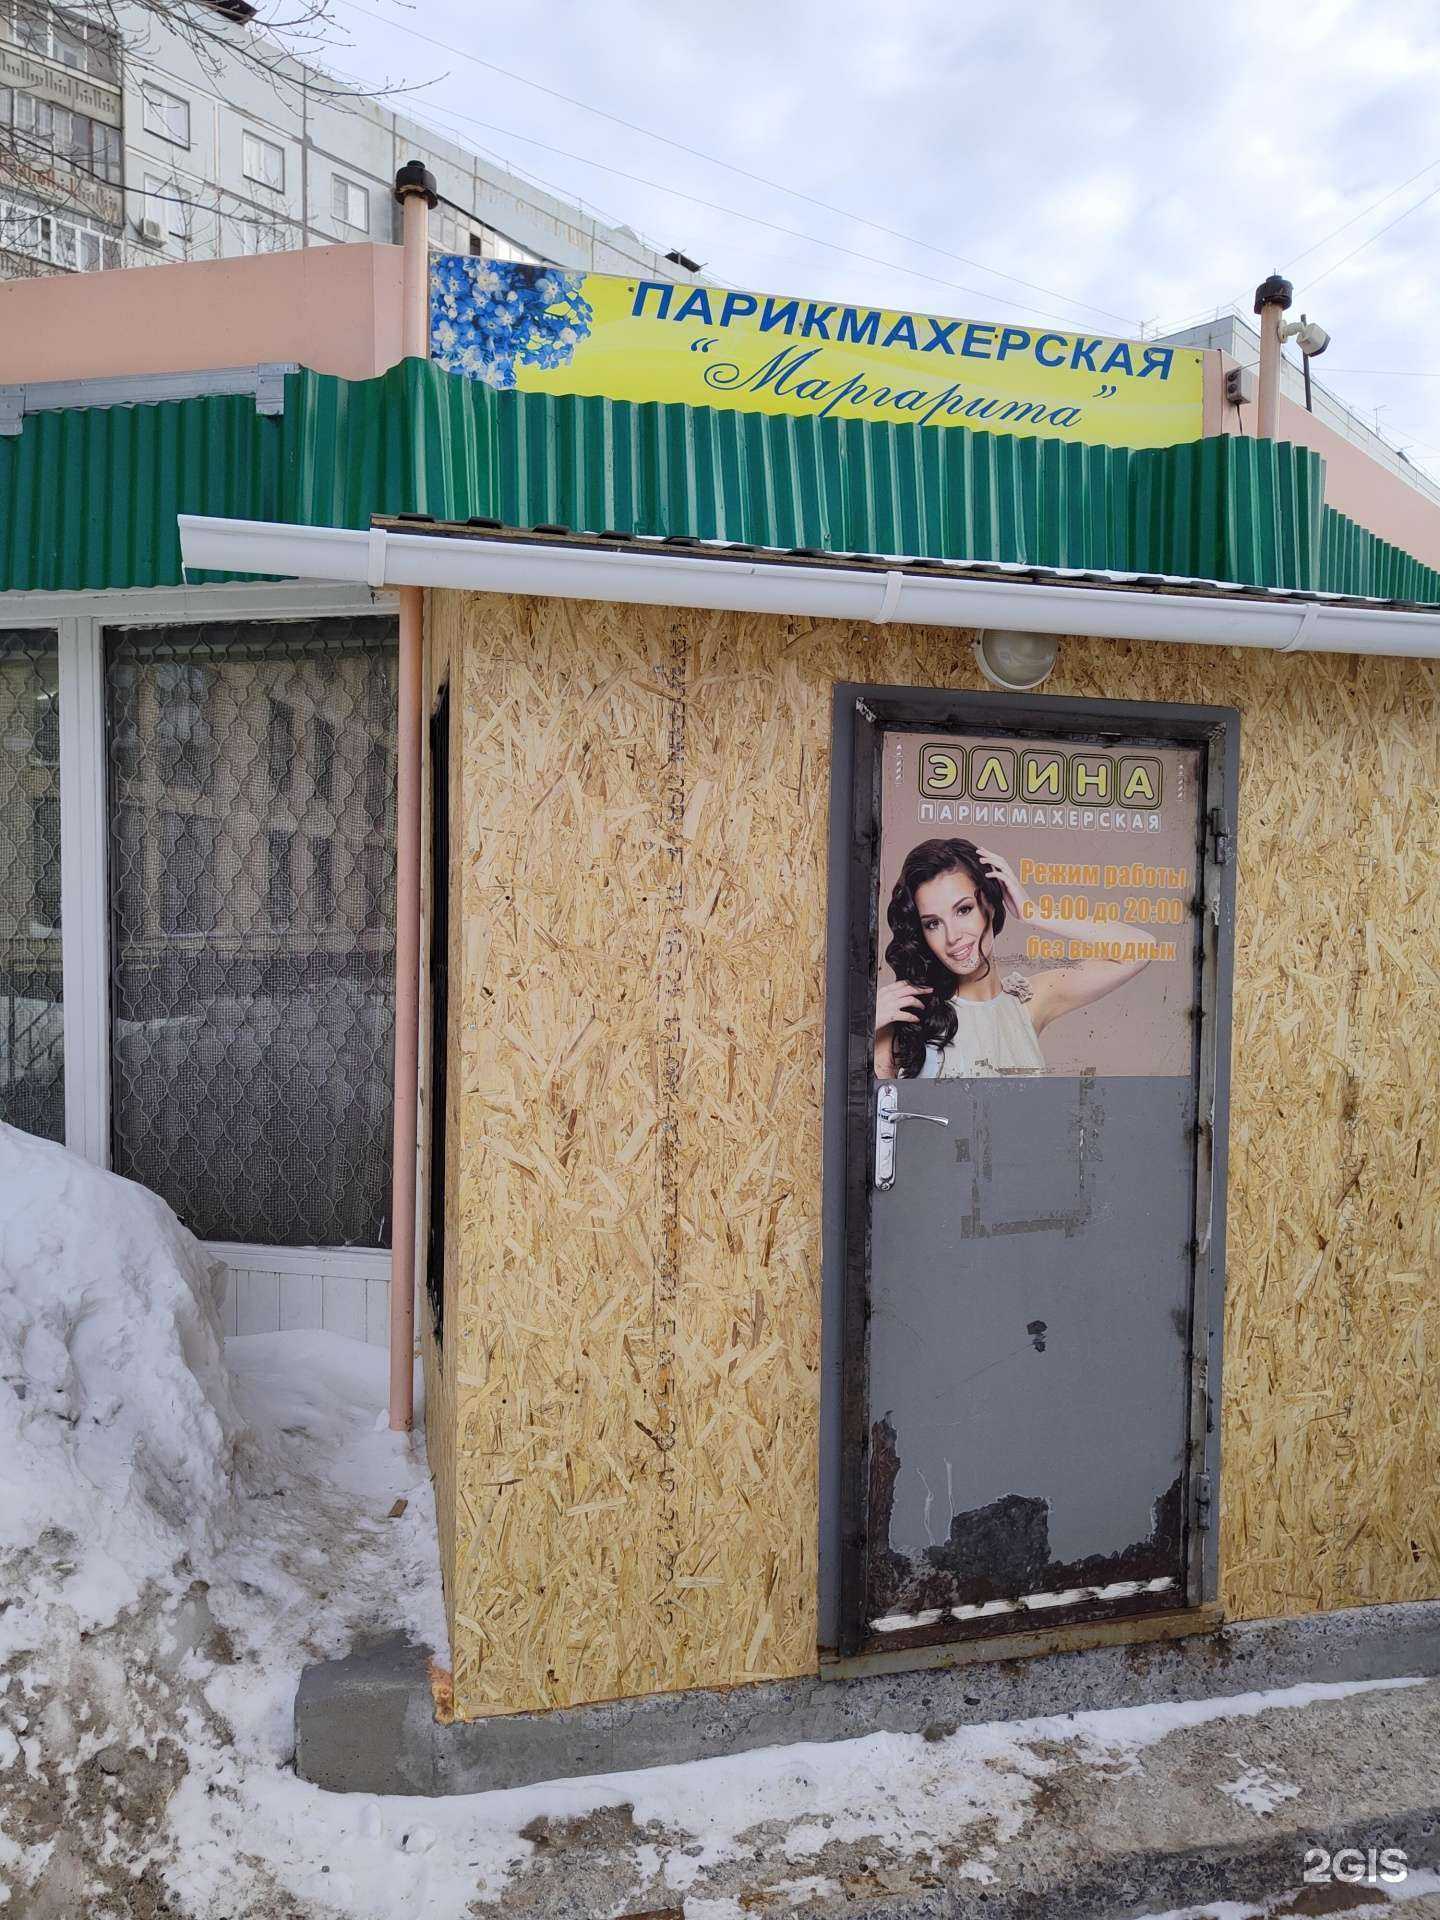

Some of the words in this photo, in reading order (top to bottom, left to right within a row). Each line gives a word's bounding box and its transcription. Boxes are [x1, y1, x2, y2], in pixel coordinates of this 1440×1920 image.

[630, 281, 1174, 381] ПАРИКМАХЕРСКАЯ
[926, 752, 1155, 801] ЭЛИНА
[919, 803, 1161, 831] ПАРИКМАХЕРСКАЯ
[1020, 857, 1100, 886] Режим
[1104, 863, 1187, 889] работы
[1022, 900, 1035, 920] с
[1039, 894, 1089, 921] 9:00
[1092, 902, 1121, 925] до
[1123, 896, 1184, 924] 20:00
[1026, 935, 1066, 960] без
[1069, 940, 1176, 961] выходных
